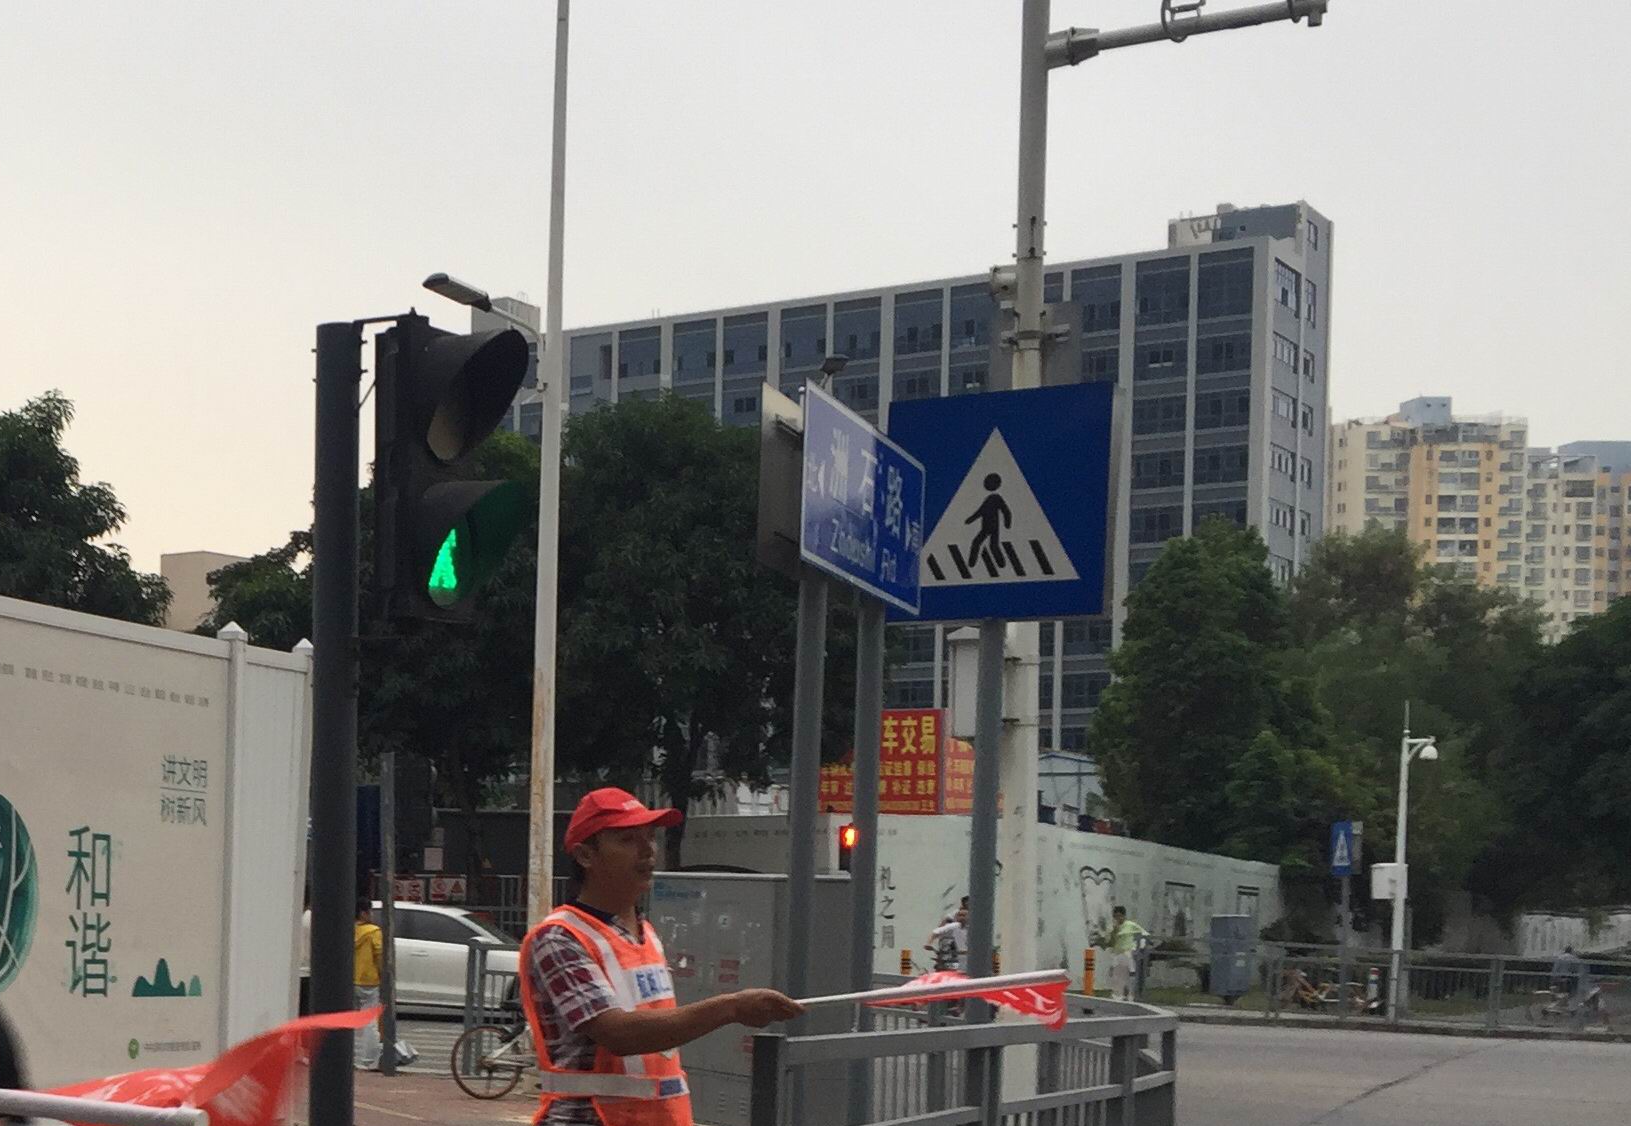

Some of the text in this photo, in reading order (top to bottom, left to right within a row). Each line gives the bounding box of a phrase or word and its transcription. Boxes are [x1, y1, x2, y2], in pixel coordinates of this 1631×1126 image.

[161, 754, 208, 788] 讲文明
[160, 794, 208, 826] 树新风
[65, 826, 112, 998] 和谐
